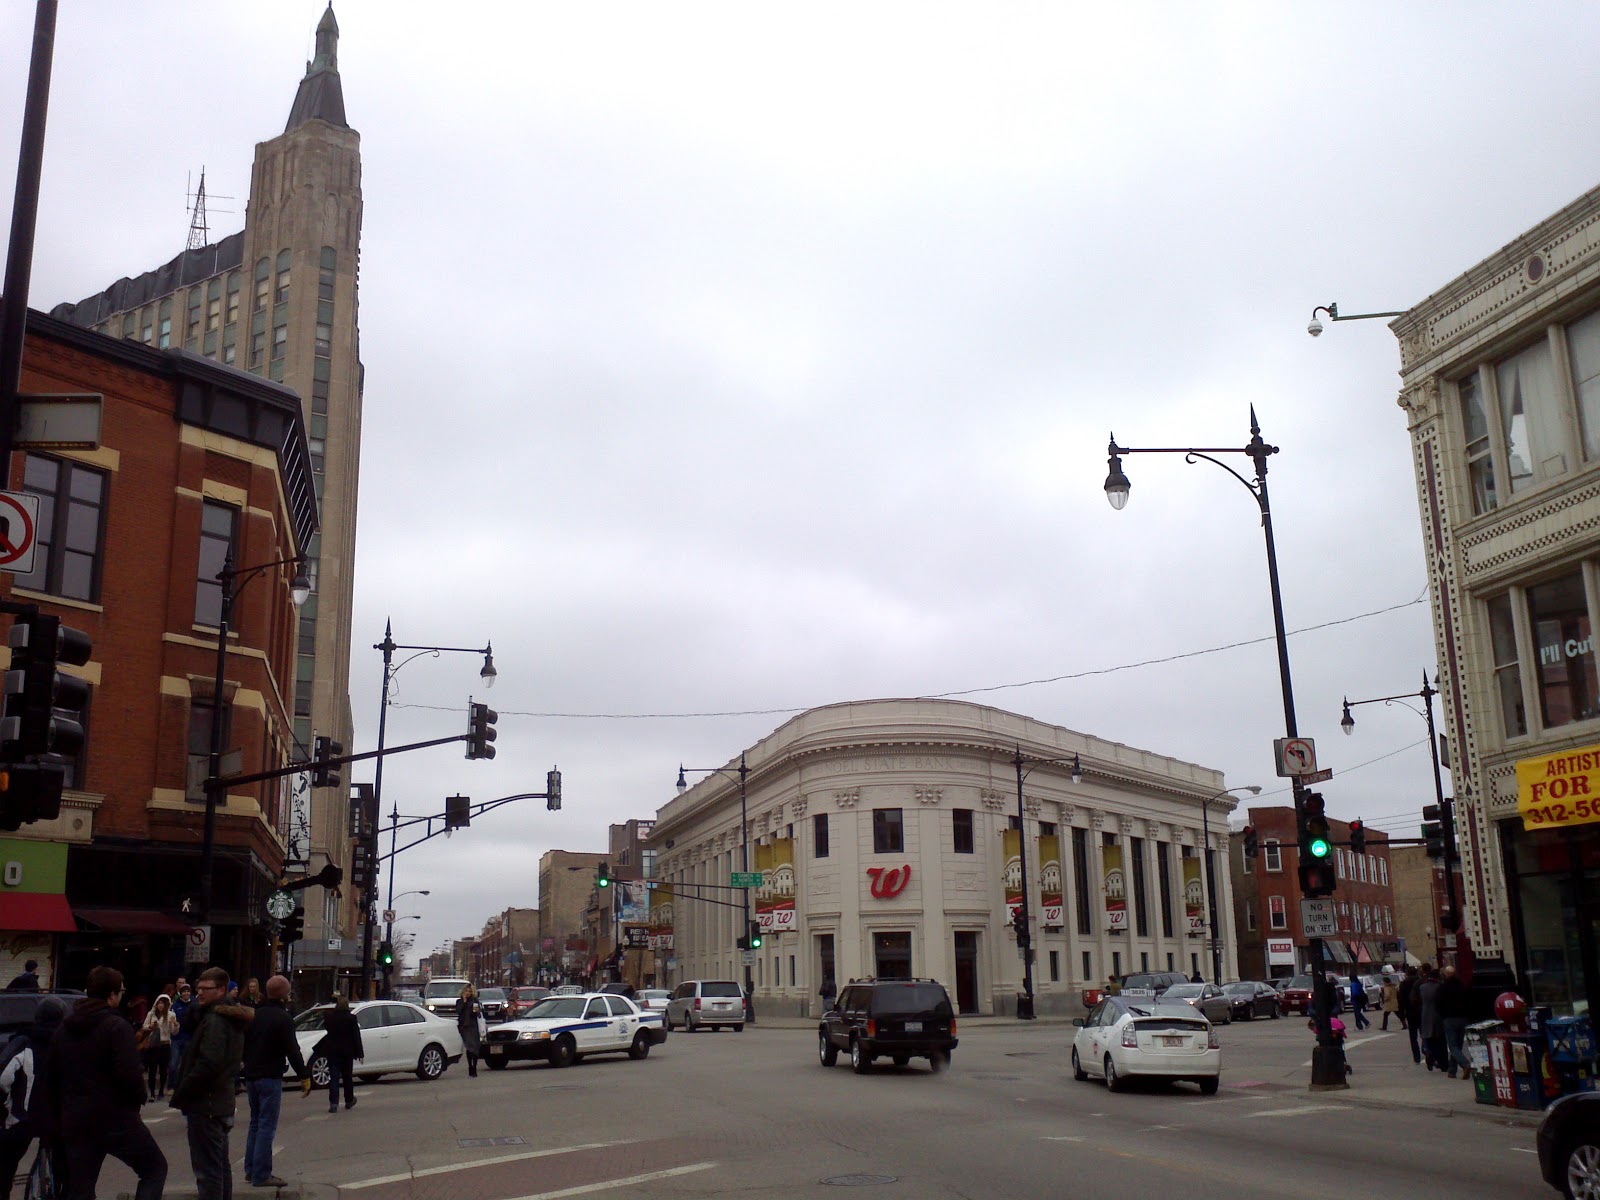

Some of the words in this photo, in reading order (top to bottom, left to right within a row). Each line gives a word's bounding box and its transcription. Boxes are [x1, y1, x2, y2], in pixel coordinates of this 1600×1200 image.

[1540, 644, 1560, 665] I'll
[1530, 775, 1592, 803] FOR
[1310, 903, 1323, 911] NO
[1308, 914, 1328, 922] TURN
[1305, 925, 1316, 933] ON
[1496, 1086, 1513, 1100] EYE
